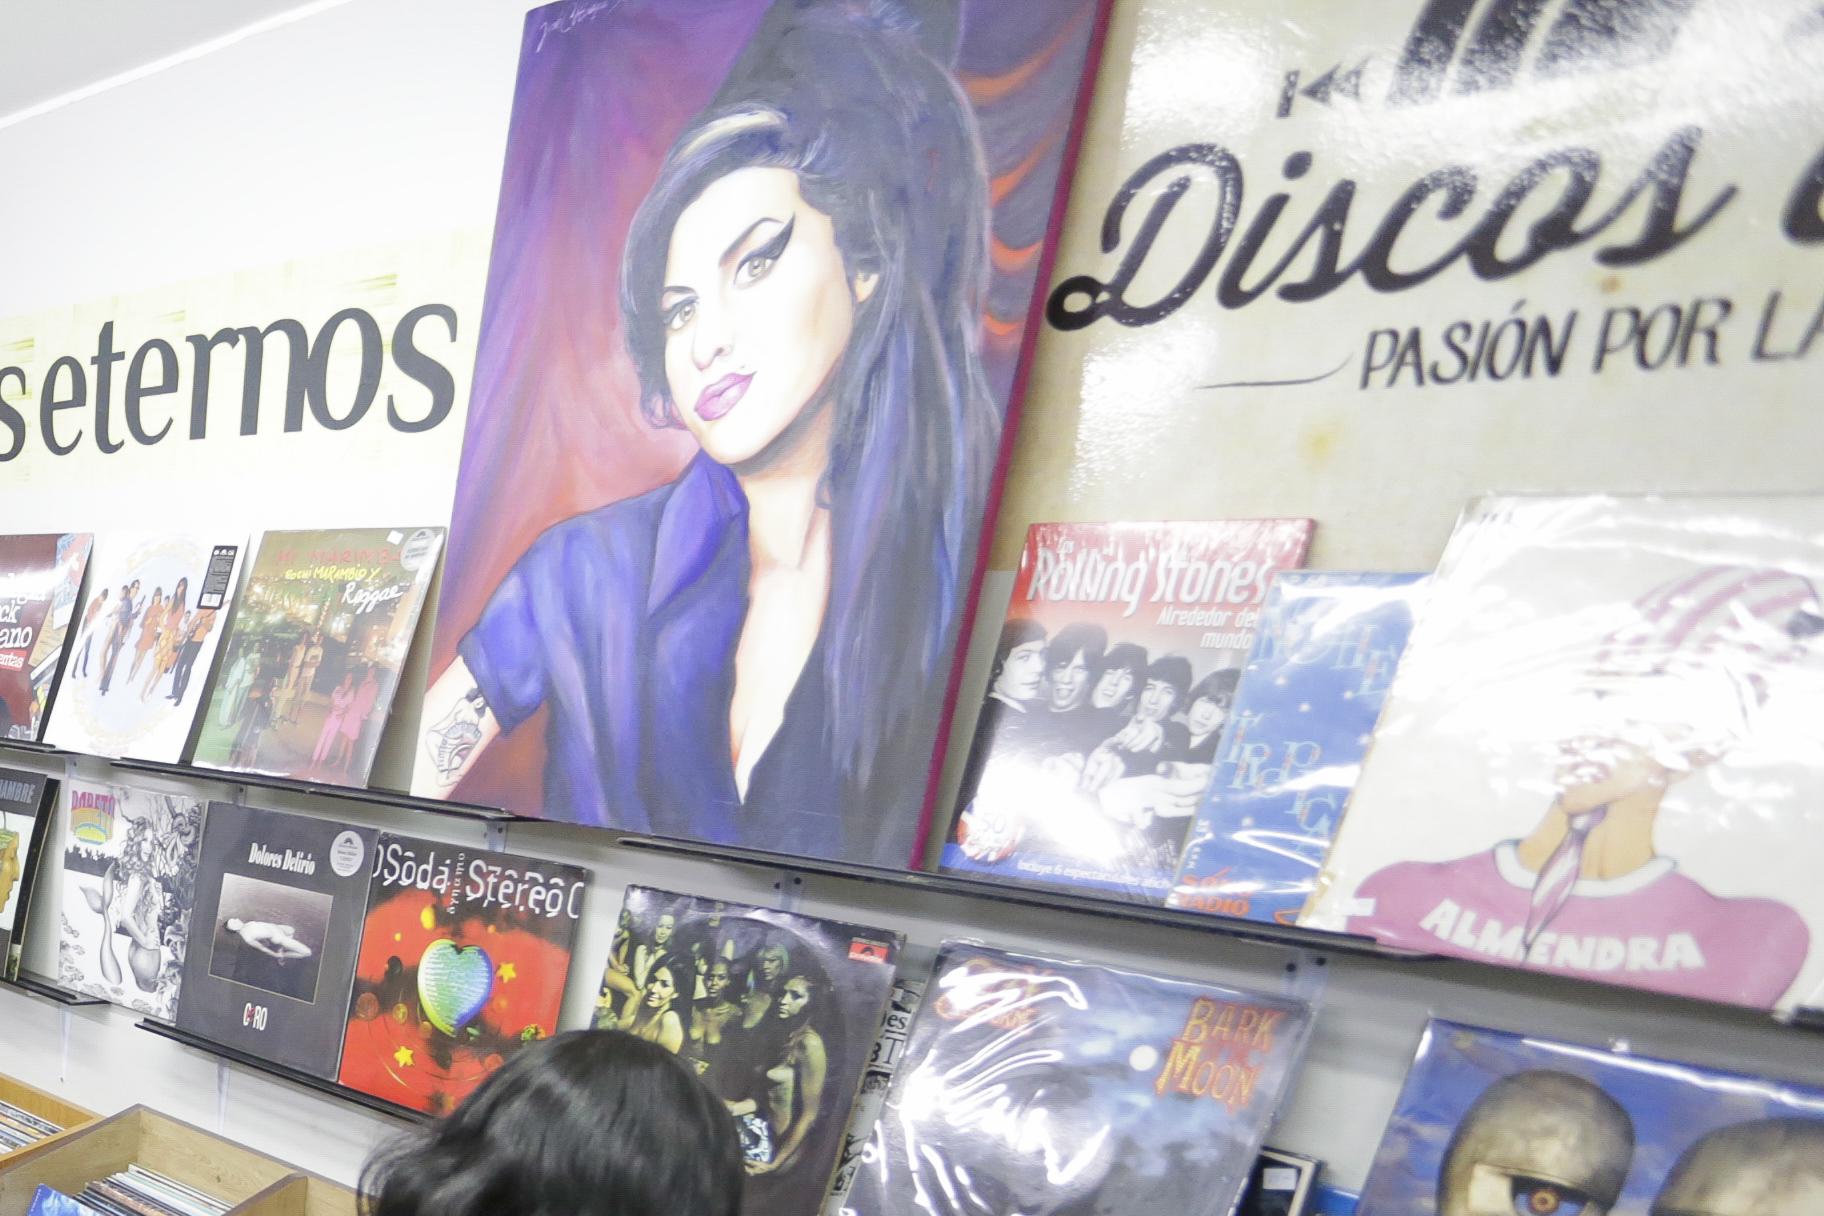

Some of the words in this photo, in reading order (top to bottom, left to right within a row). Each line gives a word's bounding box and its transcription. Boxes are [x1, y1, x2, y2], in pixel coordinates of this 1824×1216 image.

[1046, 127, 1741, 331] Discos
[1359, 301, 1577, 391] PASIÓN
[1592, 297, 1732, 372] POR
[341, 581, 403, 615] Reggae
[1027, 546, 1148, 619] Rolling
[1150, 550, 1275, 605] Stones
[1156, 607, 1232, 627] Alrededor
[1200, 632, 1252, 651] mundo
[248, 842, 282, 869] Dolores
[282, 849, 316, 876] Delirio
[382, 843, 451, 895] Soda
[465, 859, 565, 918] Stereo
[1419, 897, 1707, 972] ALMENDRA
[1181, 996, 1286, 1052] BARK
[1155, 1039, 1264, 1114] MOON
